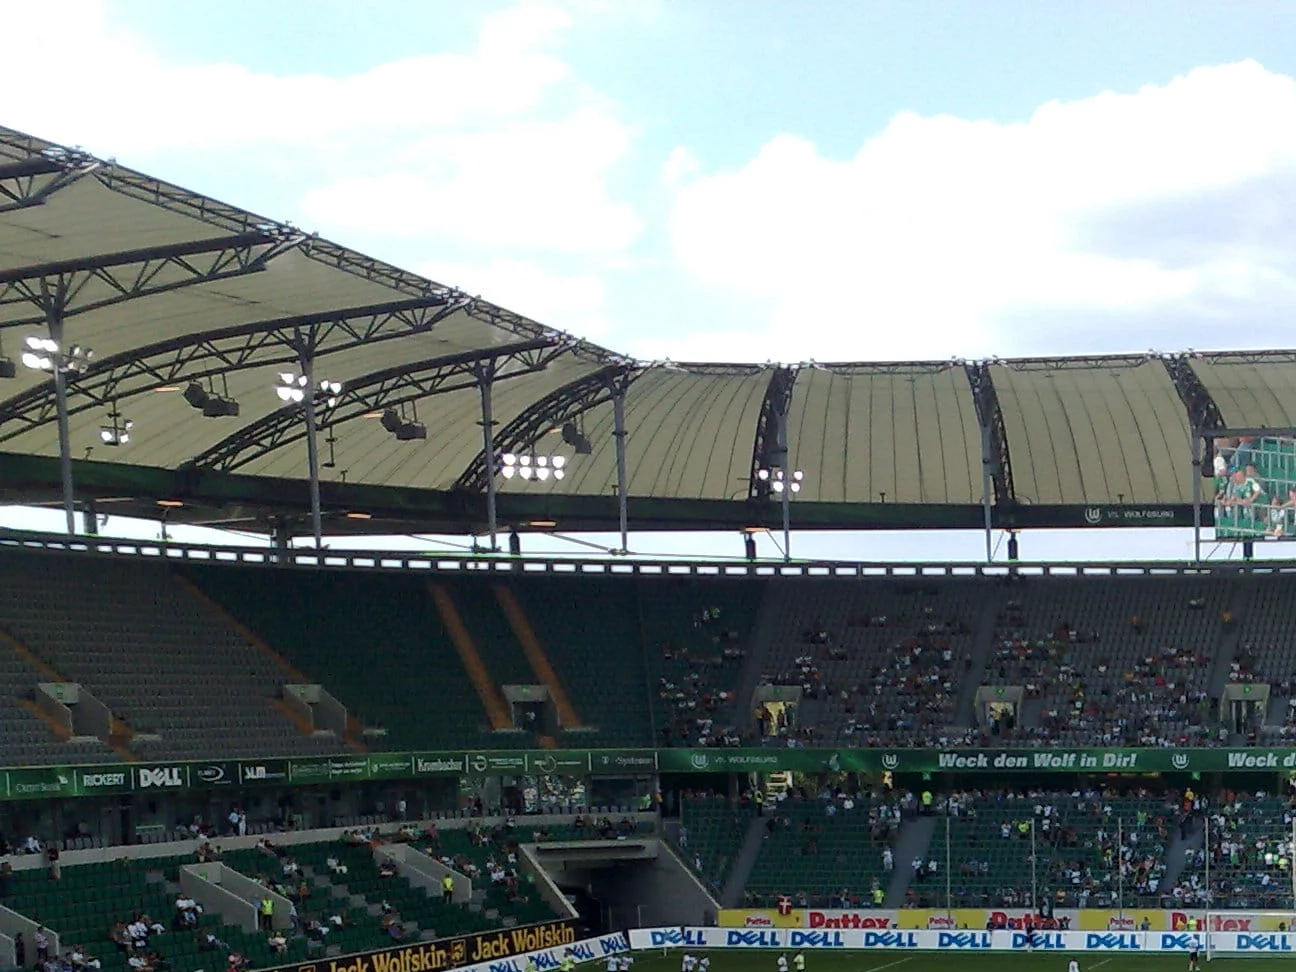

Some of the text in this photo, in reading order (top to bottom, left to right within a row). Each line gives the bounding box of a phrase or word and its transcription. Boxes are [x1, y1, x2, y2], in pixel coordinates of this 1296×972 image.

[938, 753, 1137, 768] Weck den Wolf in Dir!
[1228, 752, 1278, 767] Weck
[139, 767, 182, 788] DELL
[809, 911, 890, 929] Pattex
[472, 923, 575, 961] Jack Wolfskin
[600, 935, 629, 954] DELL
[651, 929, 707, 946] DELL
[727, 930, 780, 946] DELL
[791, 930, 844, 946] DELL
[864, 931, 917, 947] DELL
[938, 932, 991, 948] DELL
[1012, 933, 1066, 948] DELL
[1086, 933, 1140, 949] DELL
[1236, 934, 1292, 950] DELL
